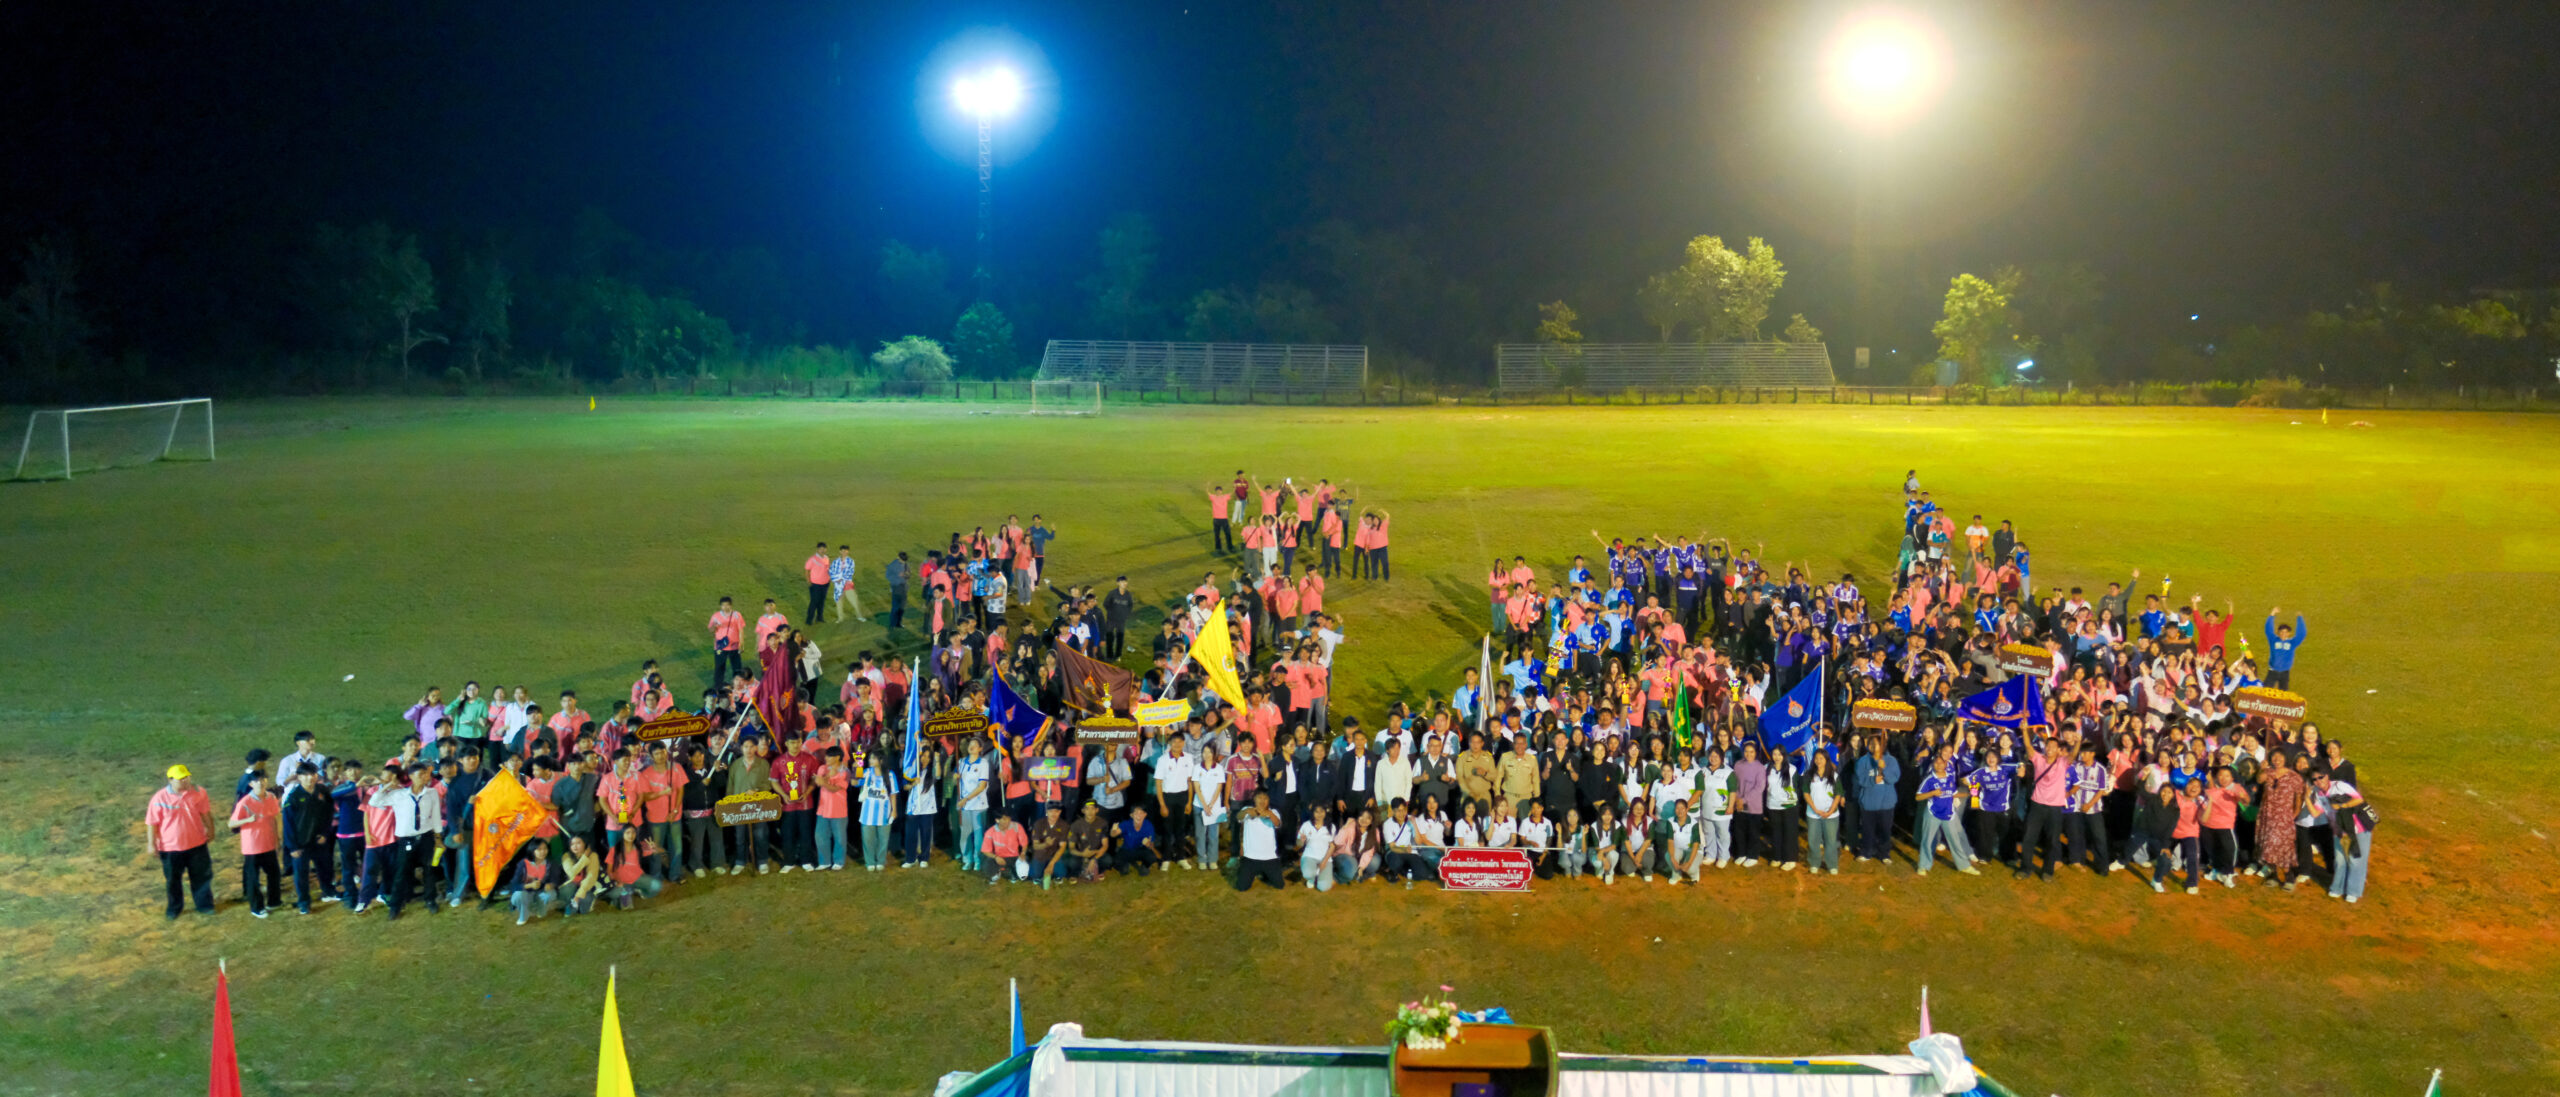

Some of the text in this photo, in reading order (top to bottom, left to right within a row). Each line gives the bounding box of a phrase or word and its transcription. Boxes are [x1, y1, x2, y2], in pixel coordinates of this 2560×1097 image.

[929, 718, 983, 733] สาขาบริหารธุรกิจ
